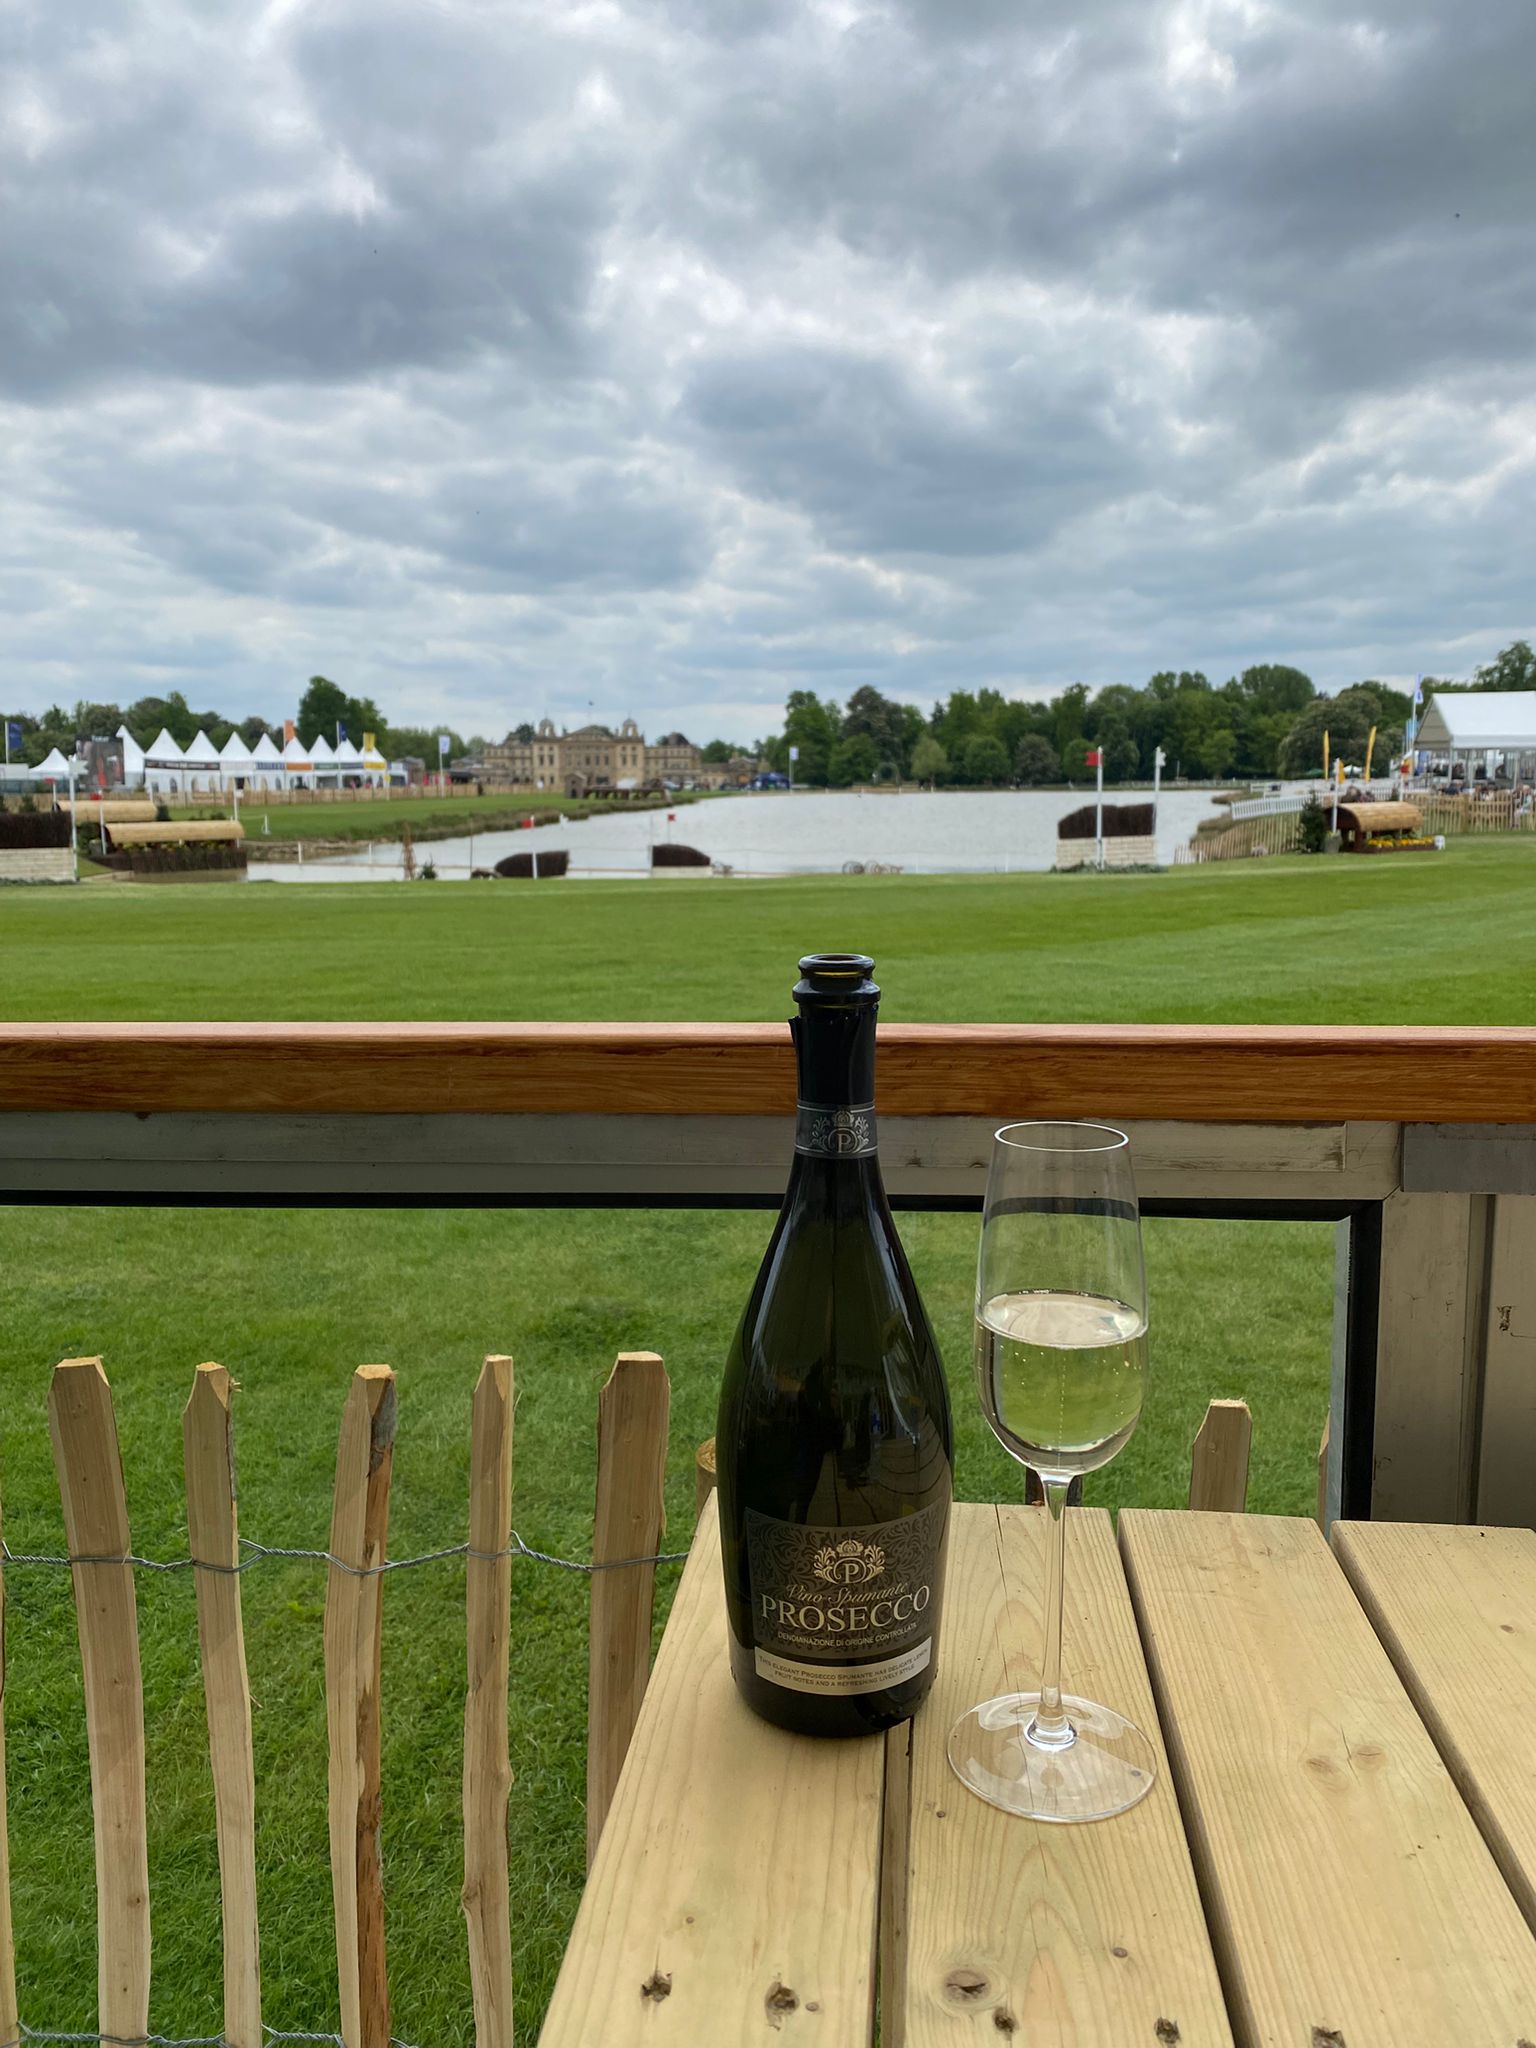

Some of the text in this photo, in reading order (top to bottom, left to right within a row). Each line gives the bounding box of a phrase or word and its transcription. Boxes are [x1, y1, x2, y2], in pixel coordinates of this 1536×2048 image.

[786, 1584, 823, 1602] Vino
[760, 1585, 930, 1632] PROSECCO
[778, 1631, 835, 1647] DENOMINAZIONE
[836, 1639, 844, 1647] DI
[845, 1637, 874, 1647] ORIGINE
[772, 1662, 800, 1675] ELEGANT
[801, 1670, 836, 1680] PROSECCO
[837, 1672, 874, 1681] SPUMANTE
